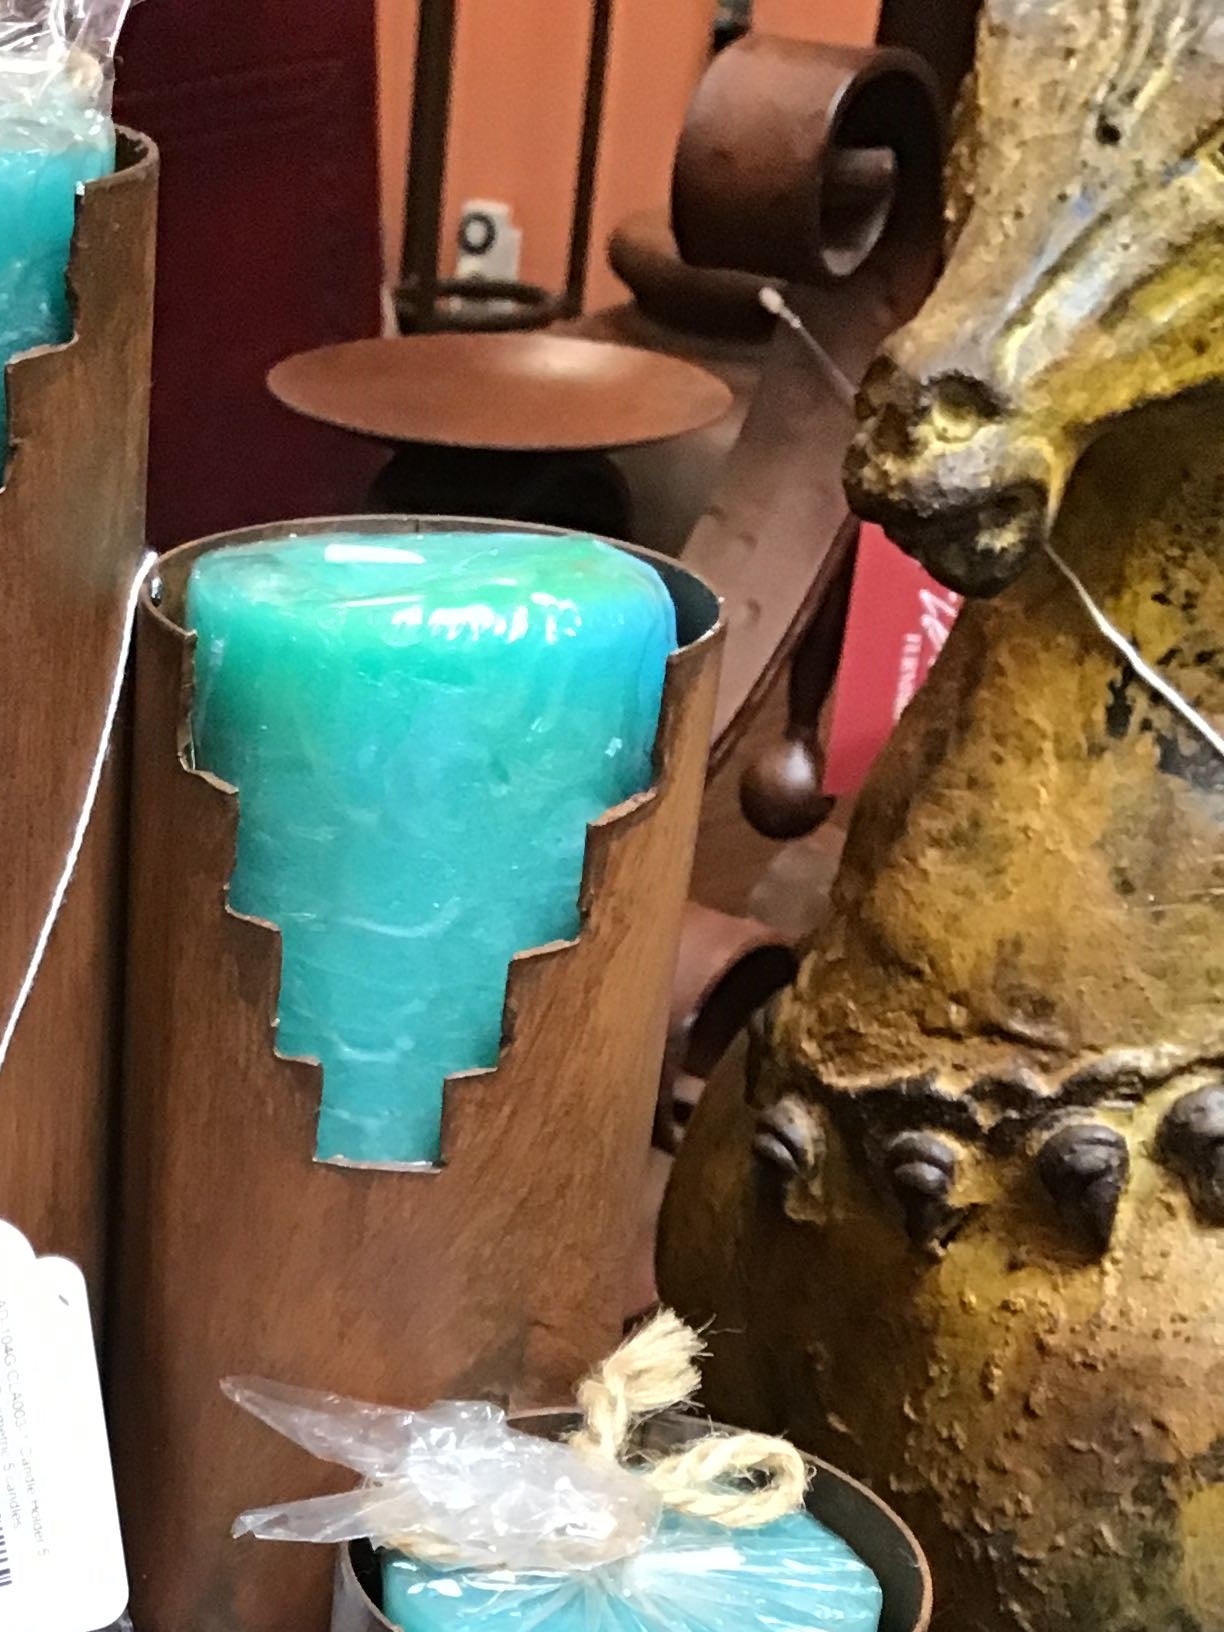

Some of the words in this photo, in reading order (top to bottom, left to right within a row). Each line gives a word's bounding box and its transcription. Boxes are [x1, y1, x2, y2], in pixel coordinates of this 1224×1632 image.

[7, 1369, 29, 1439] CLA003-
[2, 1462, 16, 1472] 5
[5, 1477, 22, 1529] candles
